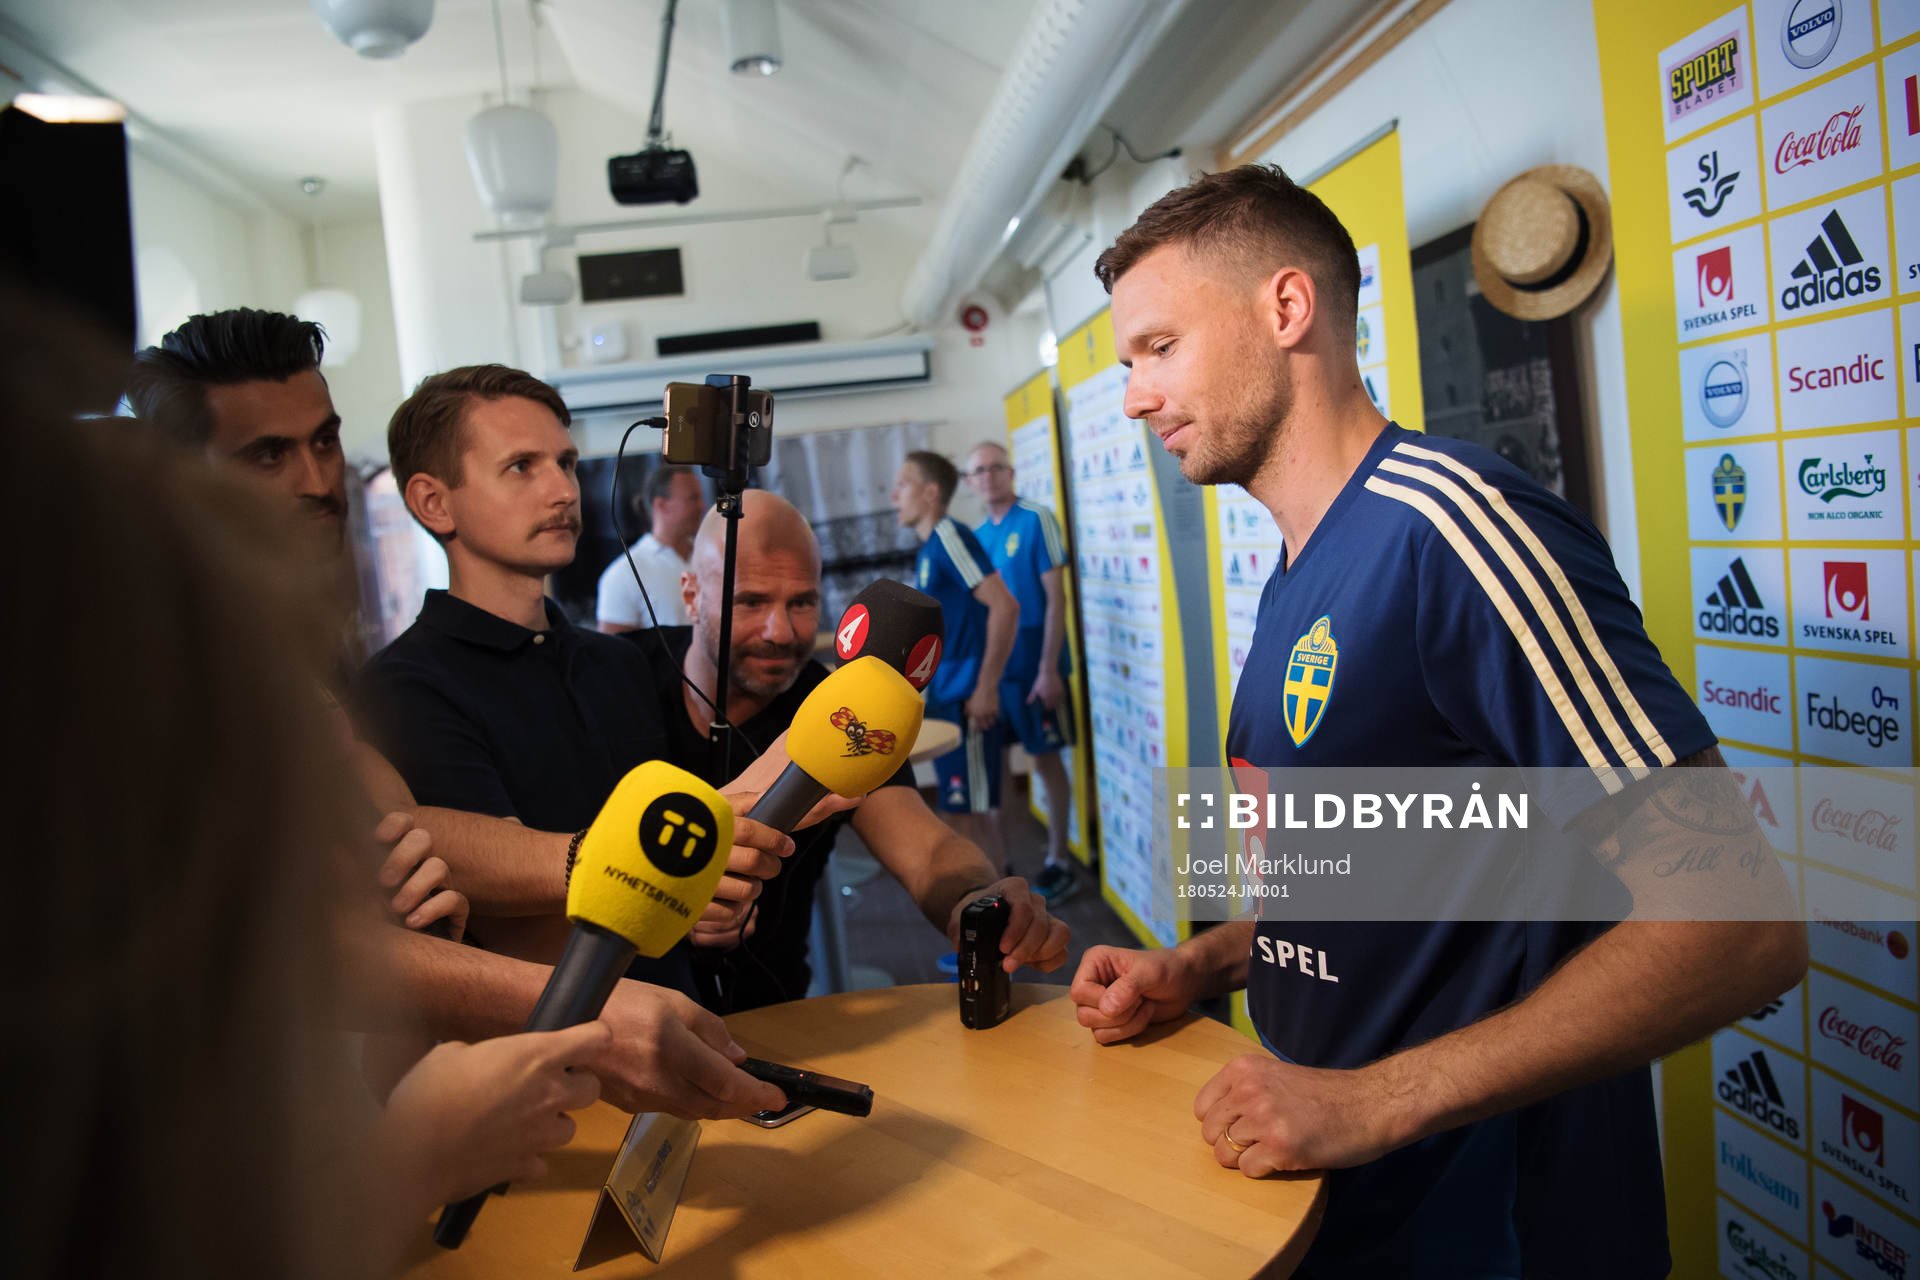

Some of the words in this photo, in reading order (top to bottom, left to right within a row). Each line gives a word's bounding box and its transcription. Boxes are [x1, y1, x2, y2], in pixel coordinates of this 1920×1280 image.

[1789, 11, 1833, 38] VOLVO
[1671, 37, 1738, 104] SPORT
[1676, 76, 1737, 115] BLADET
[1775, 103, 1866, 174] Coca-Cola
[1698, 150, 1718, 183] SJ
[1781, 266, 1881, 311] adidas
[1683, 311, 1728, 331] SVENSKA
[1730, 303, 1757, 320] SPEL
[1789, 354, 1884, 393] Scandic
[1798, 456, 1886, 500] Carlsberg
[1847, 510, 1884, 520] ORGANIC
[838, 612, 866, 654] 4
[1699, 606, 1779, 638] adidas
[1803, 624, 1862, 642] SVENSKA
[1864, 629, 1896, 646] SPEL
[908, 638, 938, 682] 4
[1296, 653, 1329, 666] SVERIGE
[1703, 680, 1782, 714] Scandic
[1807, 693, 1899, 748] Fabege
[1812, 798, 1903, 853] Coca-Cola
[1257, 935, 1339, 983] SPEL
[1818, 1005, 1907, 1071] Coca-Cola
[1718, 1080, 1799, 1140] adidas
[1721, 1141, 1799, 1210] Folksam
[1821, 1140, 1876, 1182] SVENSKA
[1878, 1175, 1909, 1203] SPEL
[1855, 1220, 1905, 1268] INTER
